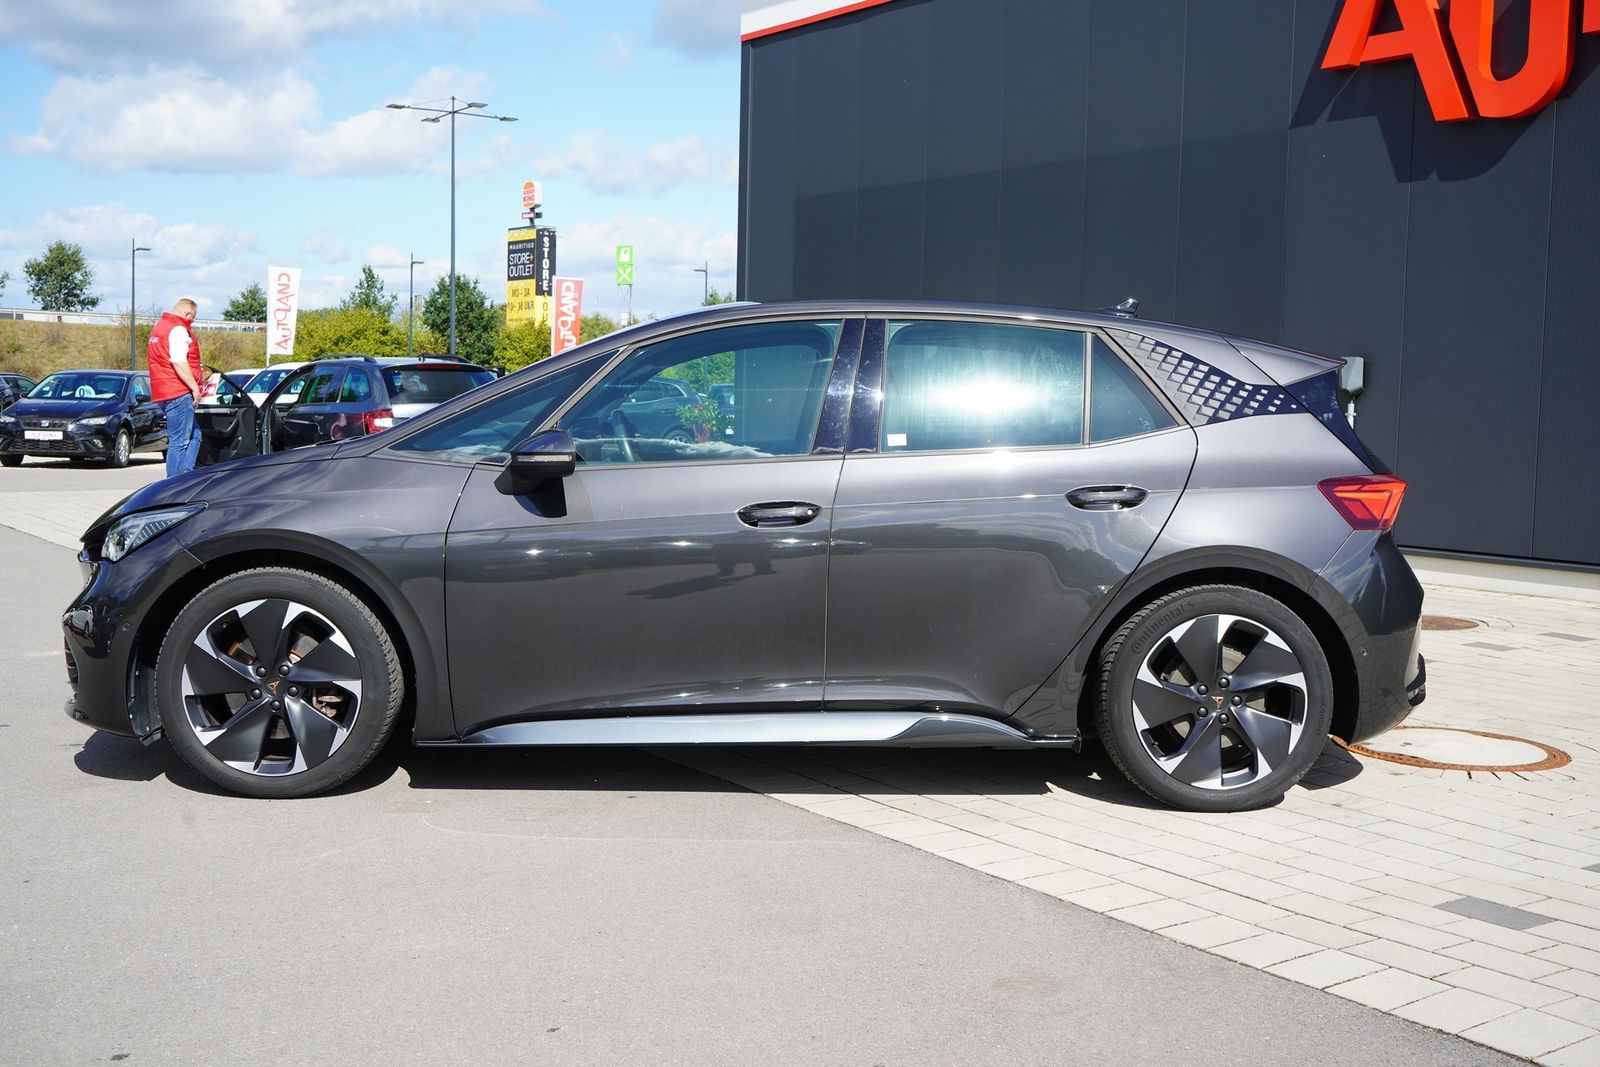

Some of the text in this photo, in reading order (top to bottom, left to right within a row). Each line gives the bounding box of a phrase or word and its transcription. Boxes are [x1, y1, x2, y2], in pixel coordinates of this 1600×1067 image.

[1321, 0, 1600, 122] AU
[509, 264, 534, 277] OUTLET
[542, 236, 550, 291] STORE
[274, 272, 295, 350] AUTOLAND
[558, 281, 578, 351] UTOLAND
[1130, 604, 1187, 655] Continental
